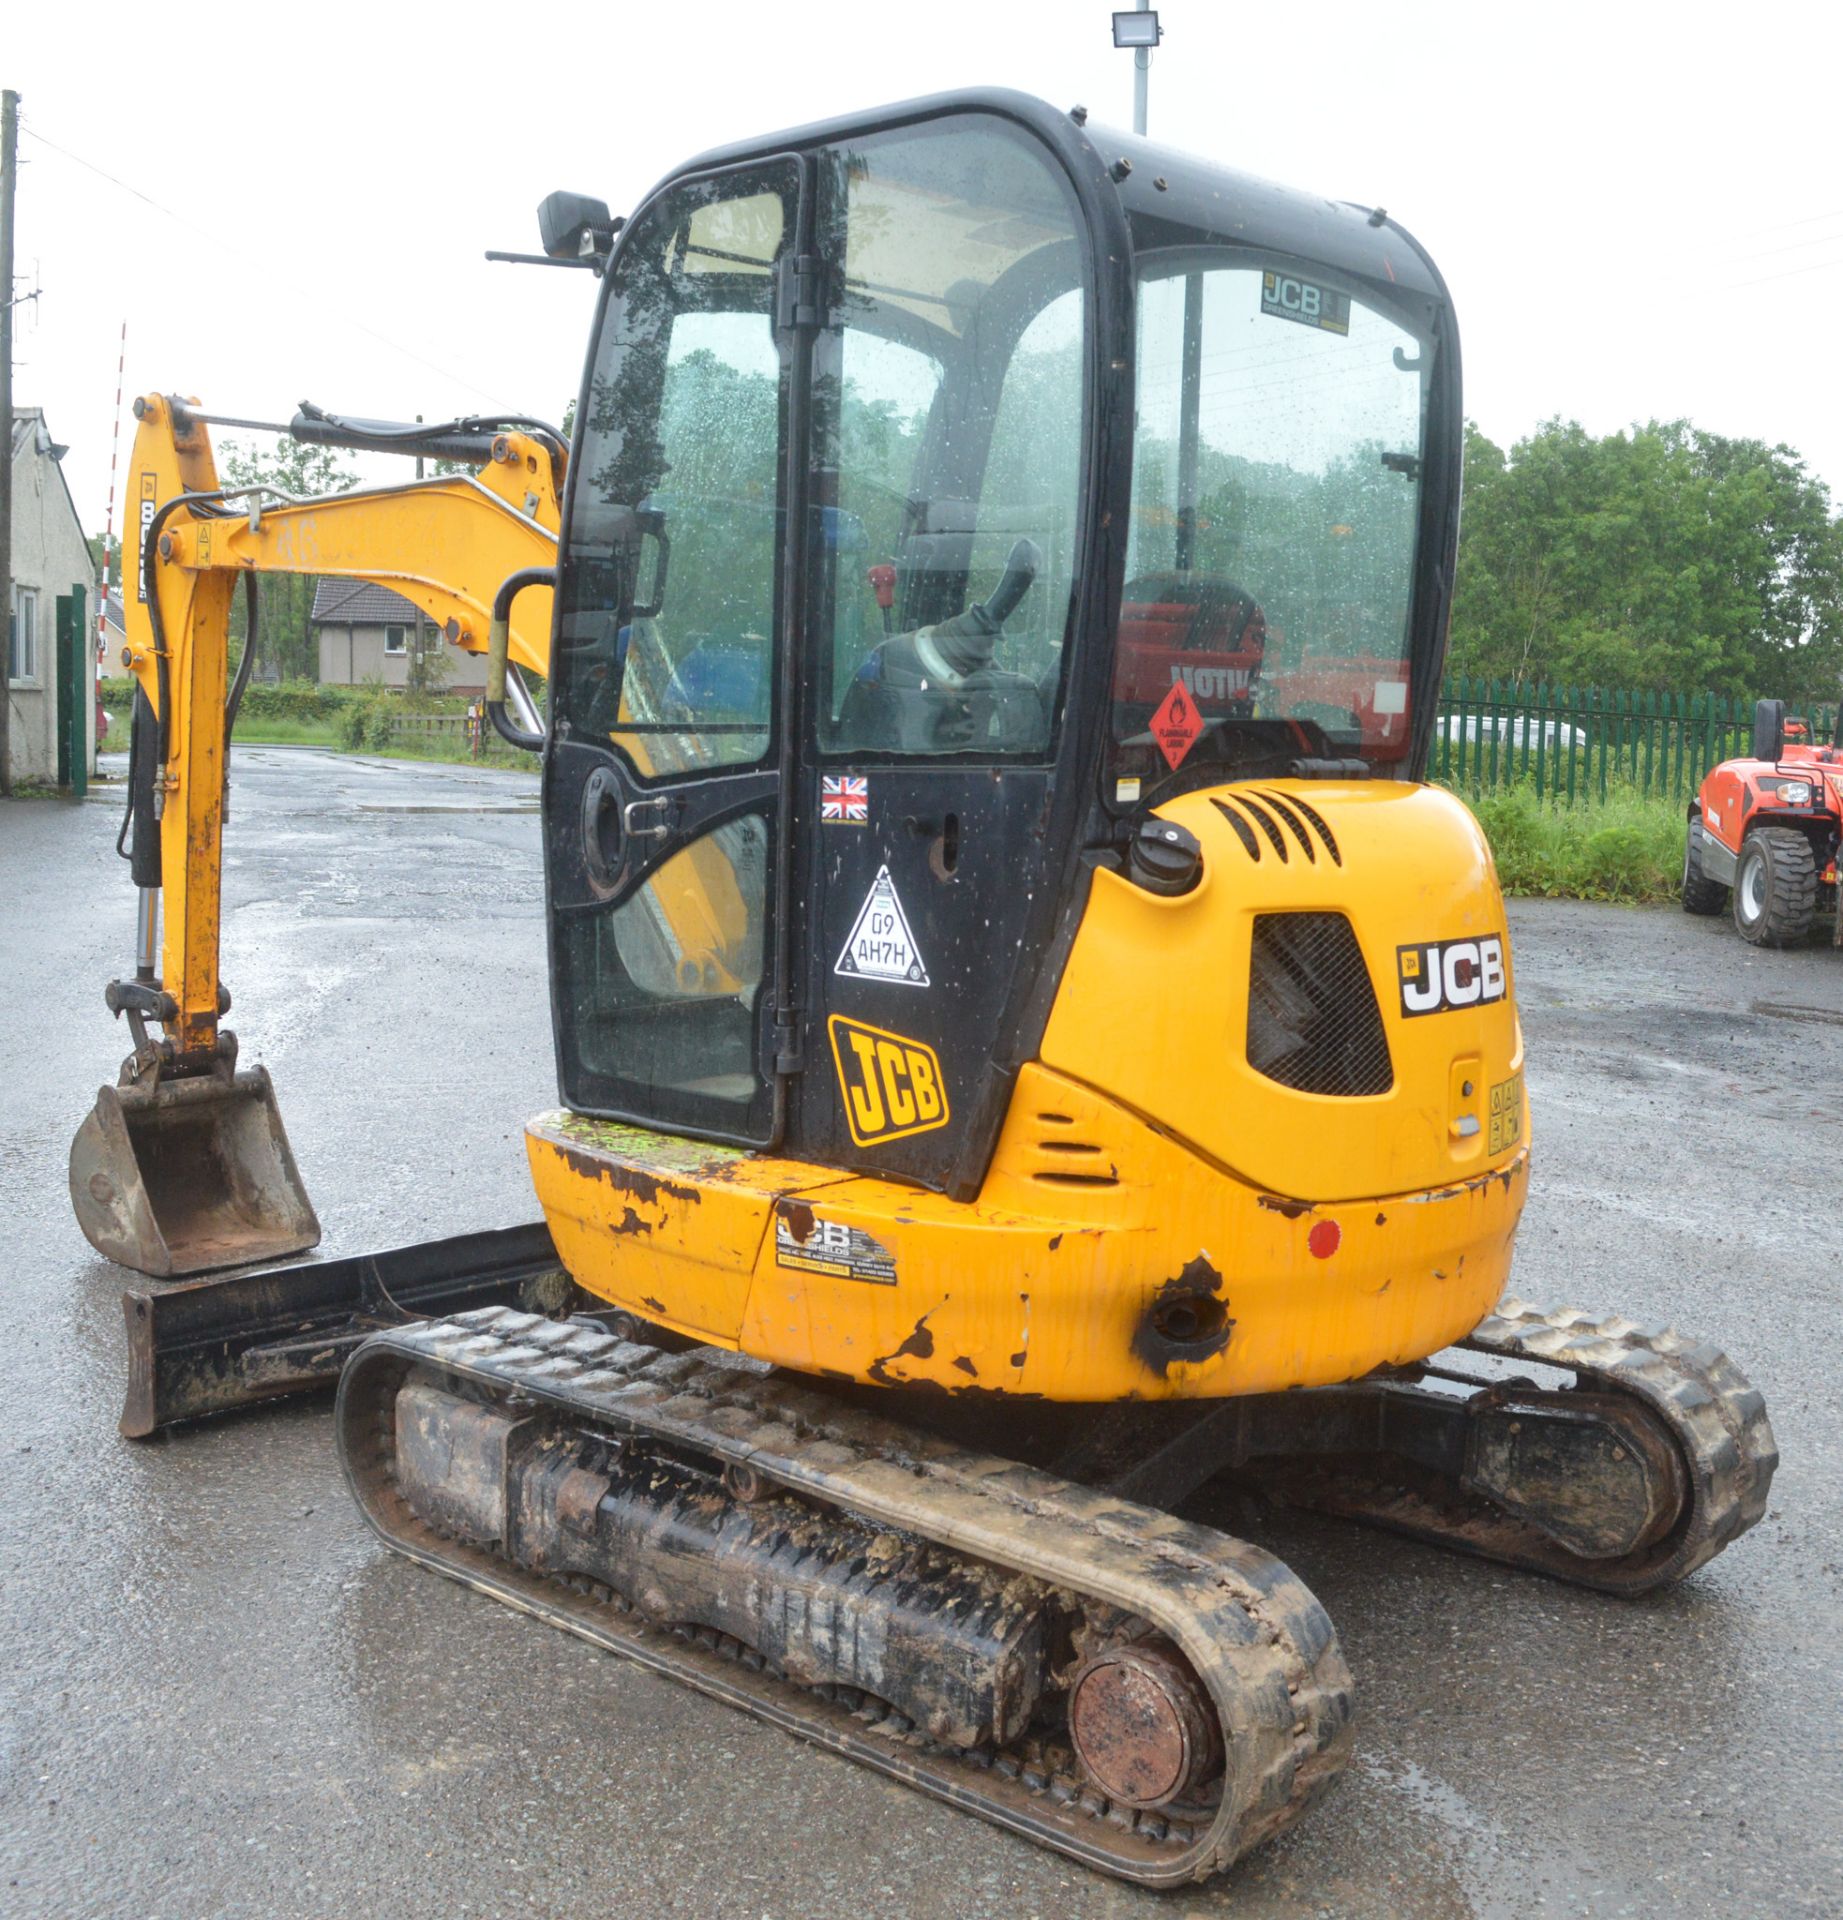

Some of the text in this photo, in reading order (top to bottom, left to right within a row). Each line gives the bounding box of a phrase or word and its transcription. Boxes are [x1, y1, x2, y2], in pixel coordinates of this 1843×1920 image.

[1264, 275, 1321, 315] JCB
[858, 939, 905, 967] AH7H
[1403, 939, 1505, 1011] JCB
[849, 1031, 940, 1133] JCB
